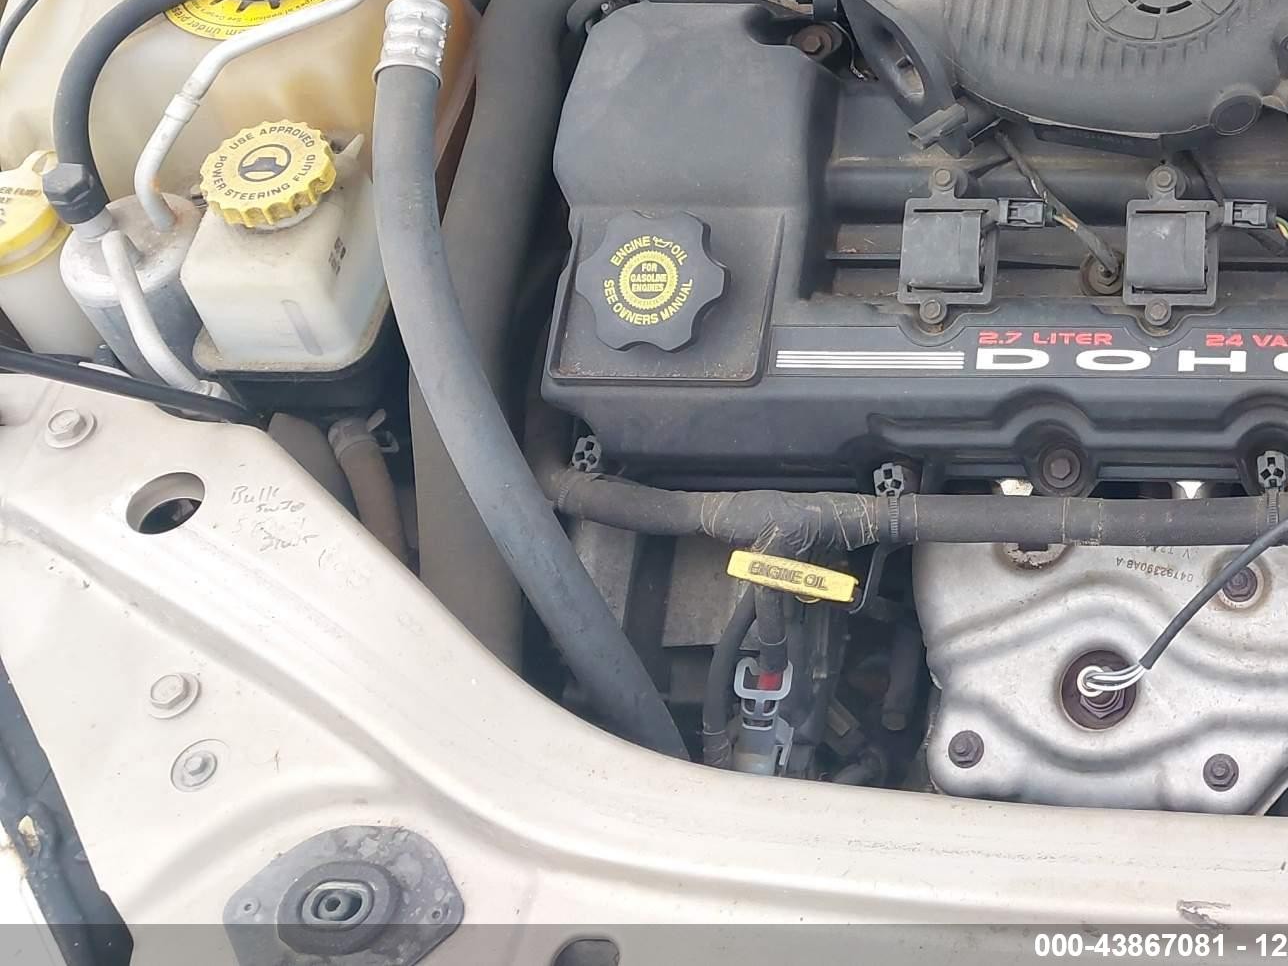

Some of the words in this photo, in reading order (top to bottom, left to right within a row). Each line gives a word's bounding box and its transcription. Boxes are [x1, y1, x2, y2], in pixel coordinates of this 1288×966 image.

[194, 19, 222, 35] under
[228, 132, 255, 150] USE
[259, 125, 316, 149] APPROVED
[211, 154, 228, 191] POWER
[223, 181, 291, 201] STEERING
[292, 153, 317, 183] FLUID
[610, 235, 651, 267] ENGINE
[670, 244, 689, 266] OIL
[641, 262, 658, 273] FOR
[630, 273, 668, 283] GASOLINE
[631, 283, 666, 293] ENGINES
[603, 278, 619, 305] SEE
[612, 302, 660, 325] OWNERS
[659, 278, 693, 321] MANUAL
[979, 332, 1023, 345] 2.7
[1032, 332, 1113, 346] LITER
[1205, 334, 1244, 347] 24
[749, 560, 804, 584] ENGINE
[803, 573, 828, 591] OIL
